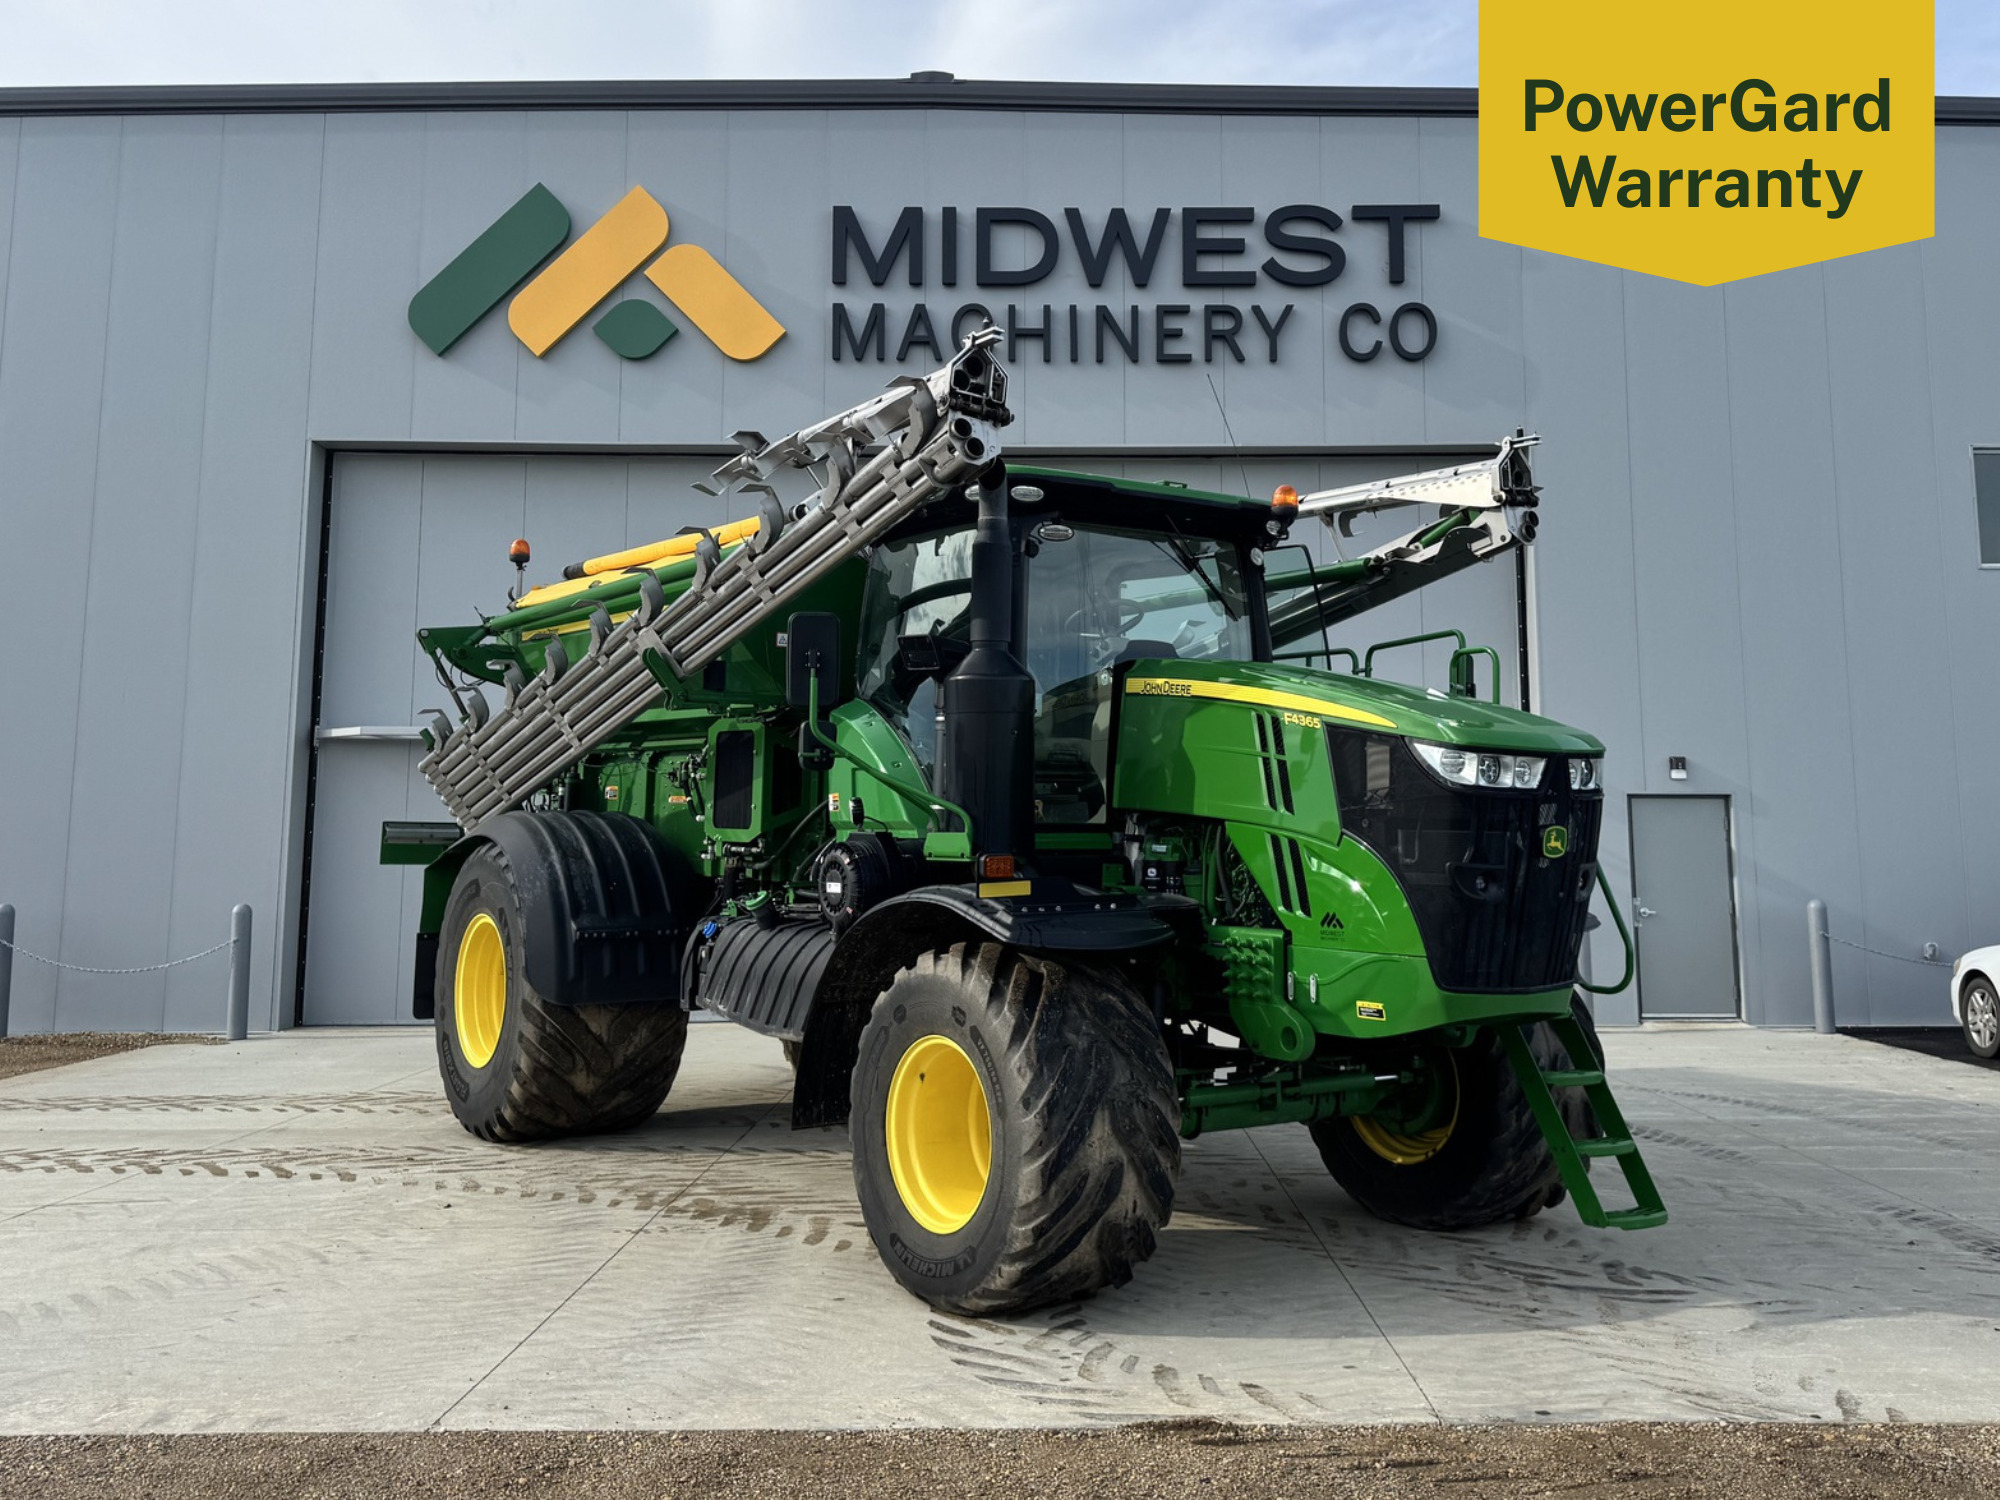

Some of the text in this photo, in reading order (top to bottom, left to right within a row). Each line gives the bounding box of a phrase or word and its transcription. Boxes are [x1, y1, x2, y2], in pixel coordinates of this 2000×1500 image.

[832, 204, 1440, 287] MIDWEST
[832, 302, 1437, 363] MACHINERY CO
[1284, 712, 1321, 729] F4365
[894, 1242, 954, 1277] MICHELIN
